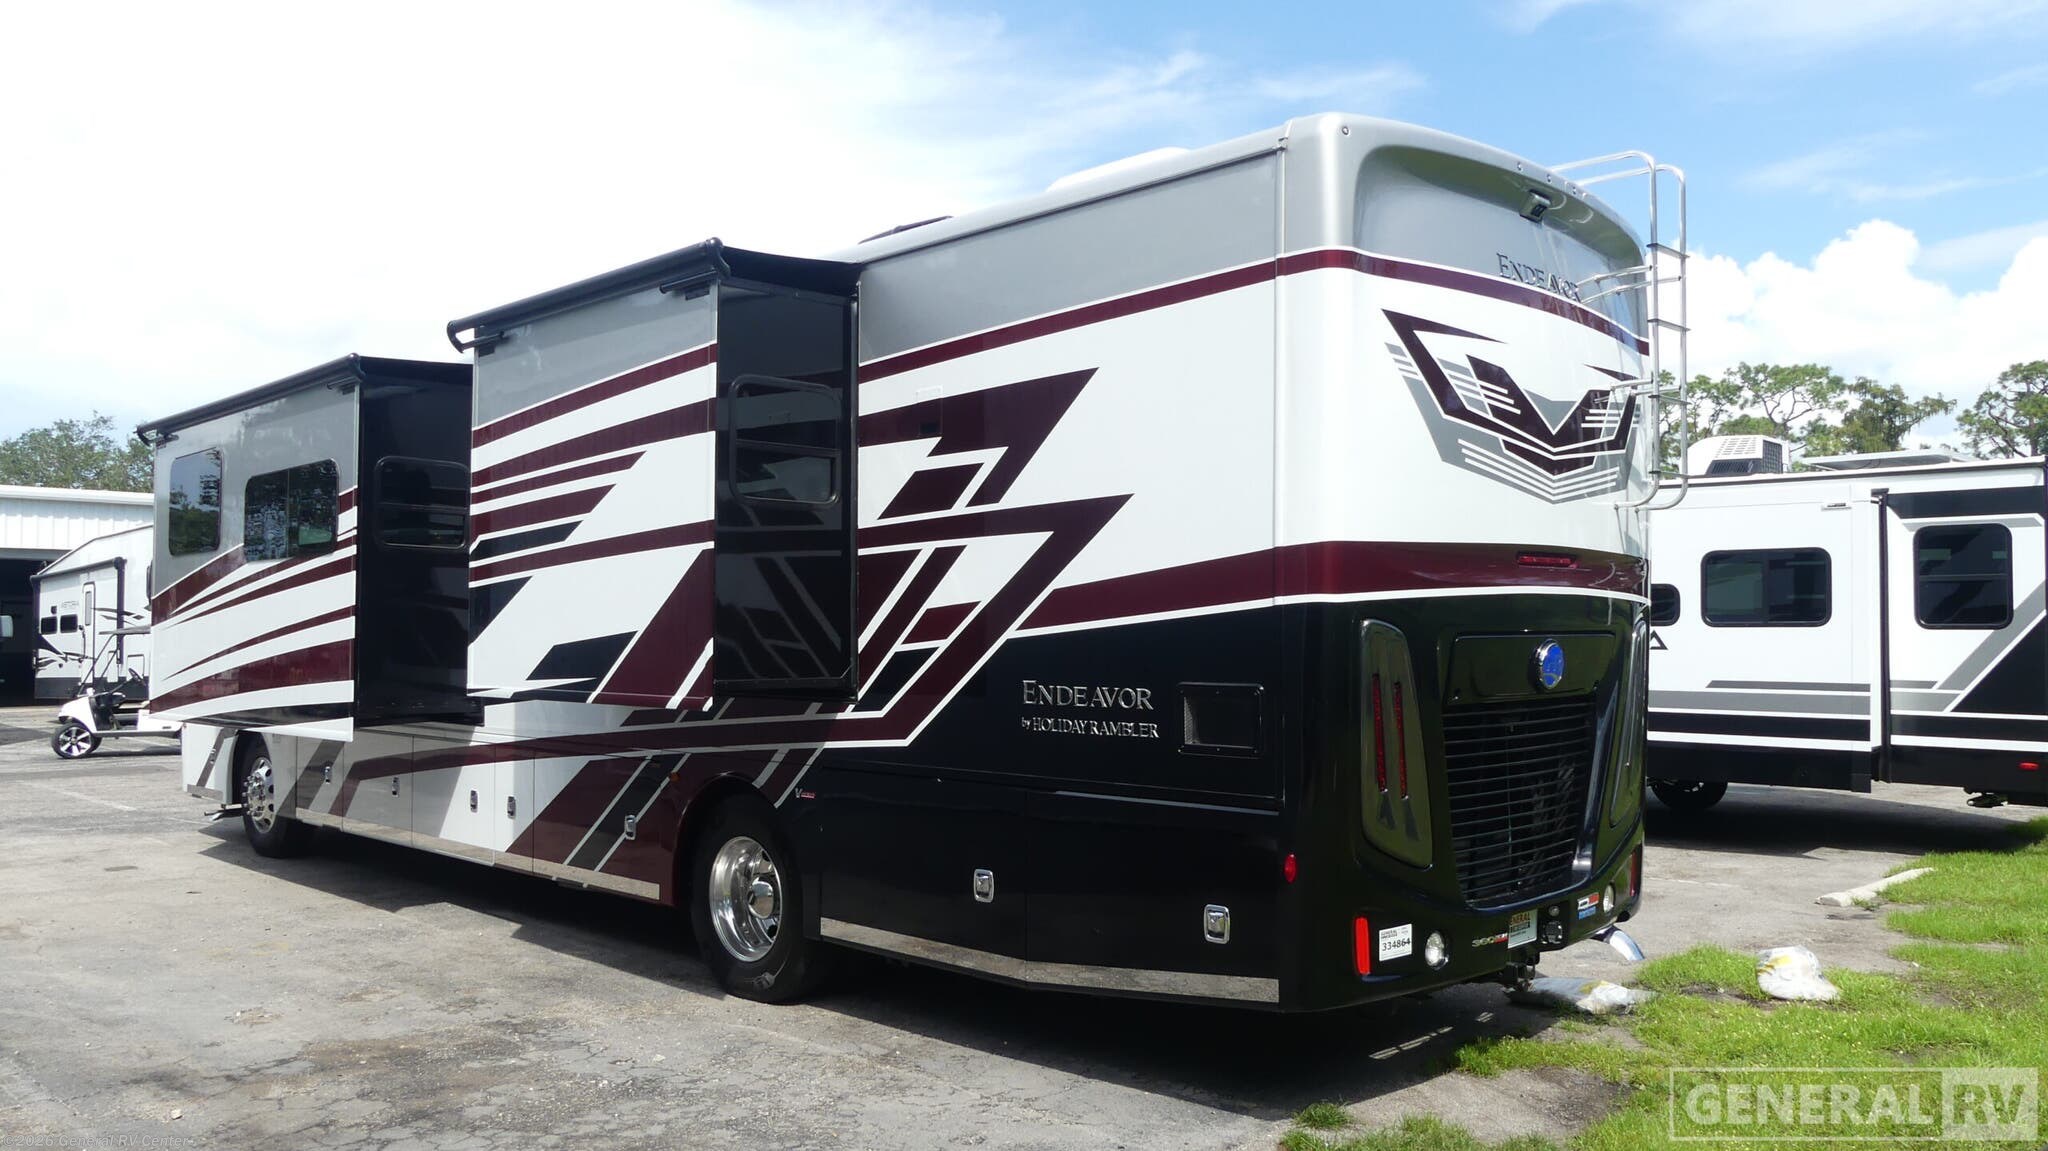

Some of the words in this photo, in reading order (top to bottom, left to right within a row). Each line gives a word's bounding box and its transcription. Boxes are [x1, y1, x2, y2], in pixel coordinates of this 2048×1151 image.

[1496, 252, 1581, 303] ENDEAVOR
[1022, 679, 1154, 711] ENDEAVOR
[1021, 716, 1031, 730] by
[1032, 716, 1088, 735] HOLIDAY
[1089, 720, 1160, 738] RAMBLER
